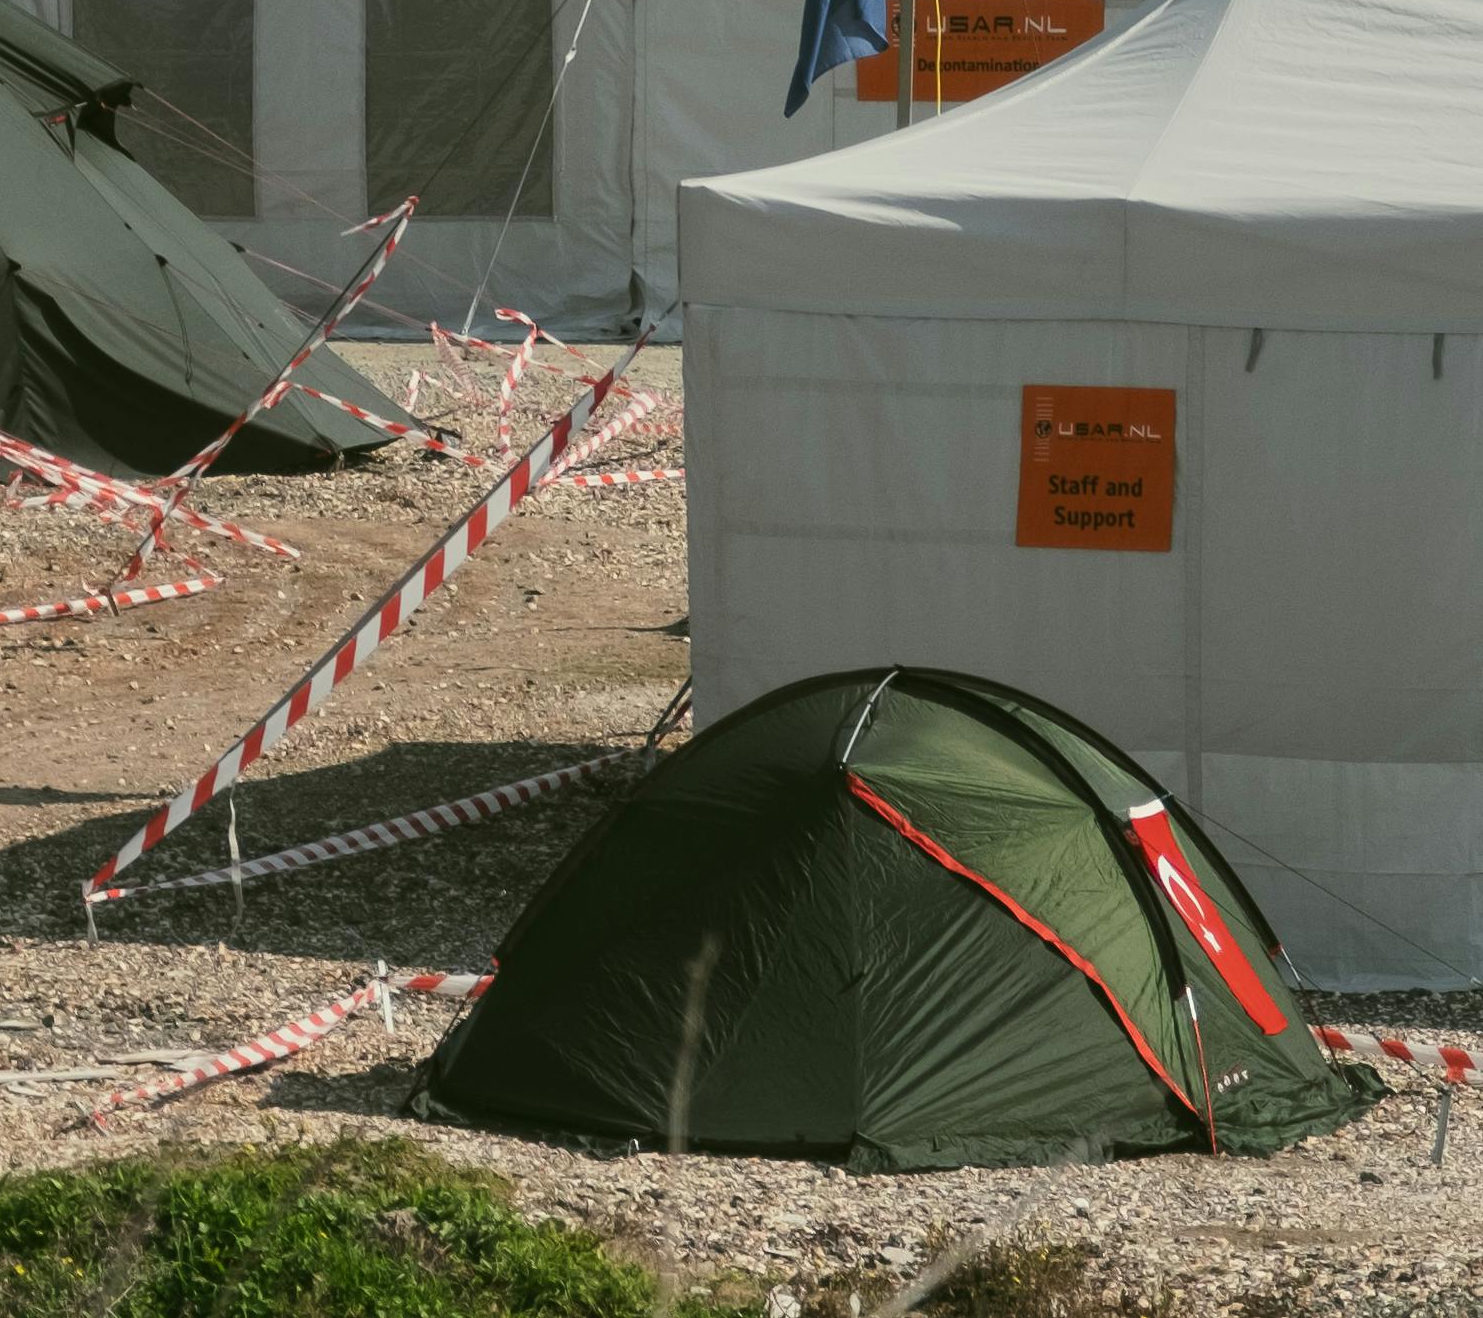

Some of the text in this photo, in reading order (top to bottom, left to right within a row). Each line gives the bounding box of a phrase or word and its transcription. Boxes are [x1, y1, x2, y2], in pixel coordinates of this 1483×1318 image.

[925, 15, 1068, 35] USAR.NL
[1057, 421, 1162, 439] USAR.NL
[1048, 474, 1143, 497] Staff and
[1053, 505, 1136, 531] Support
